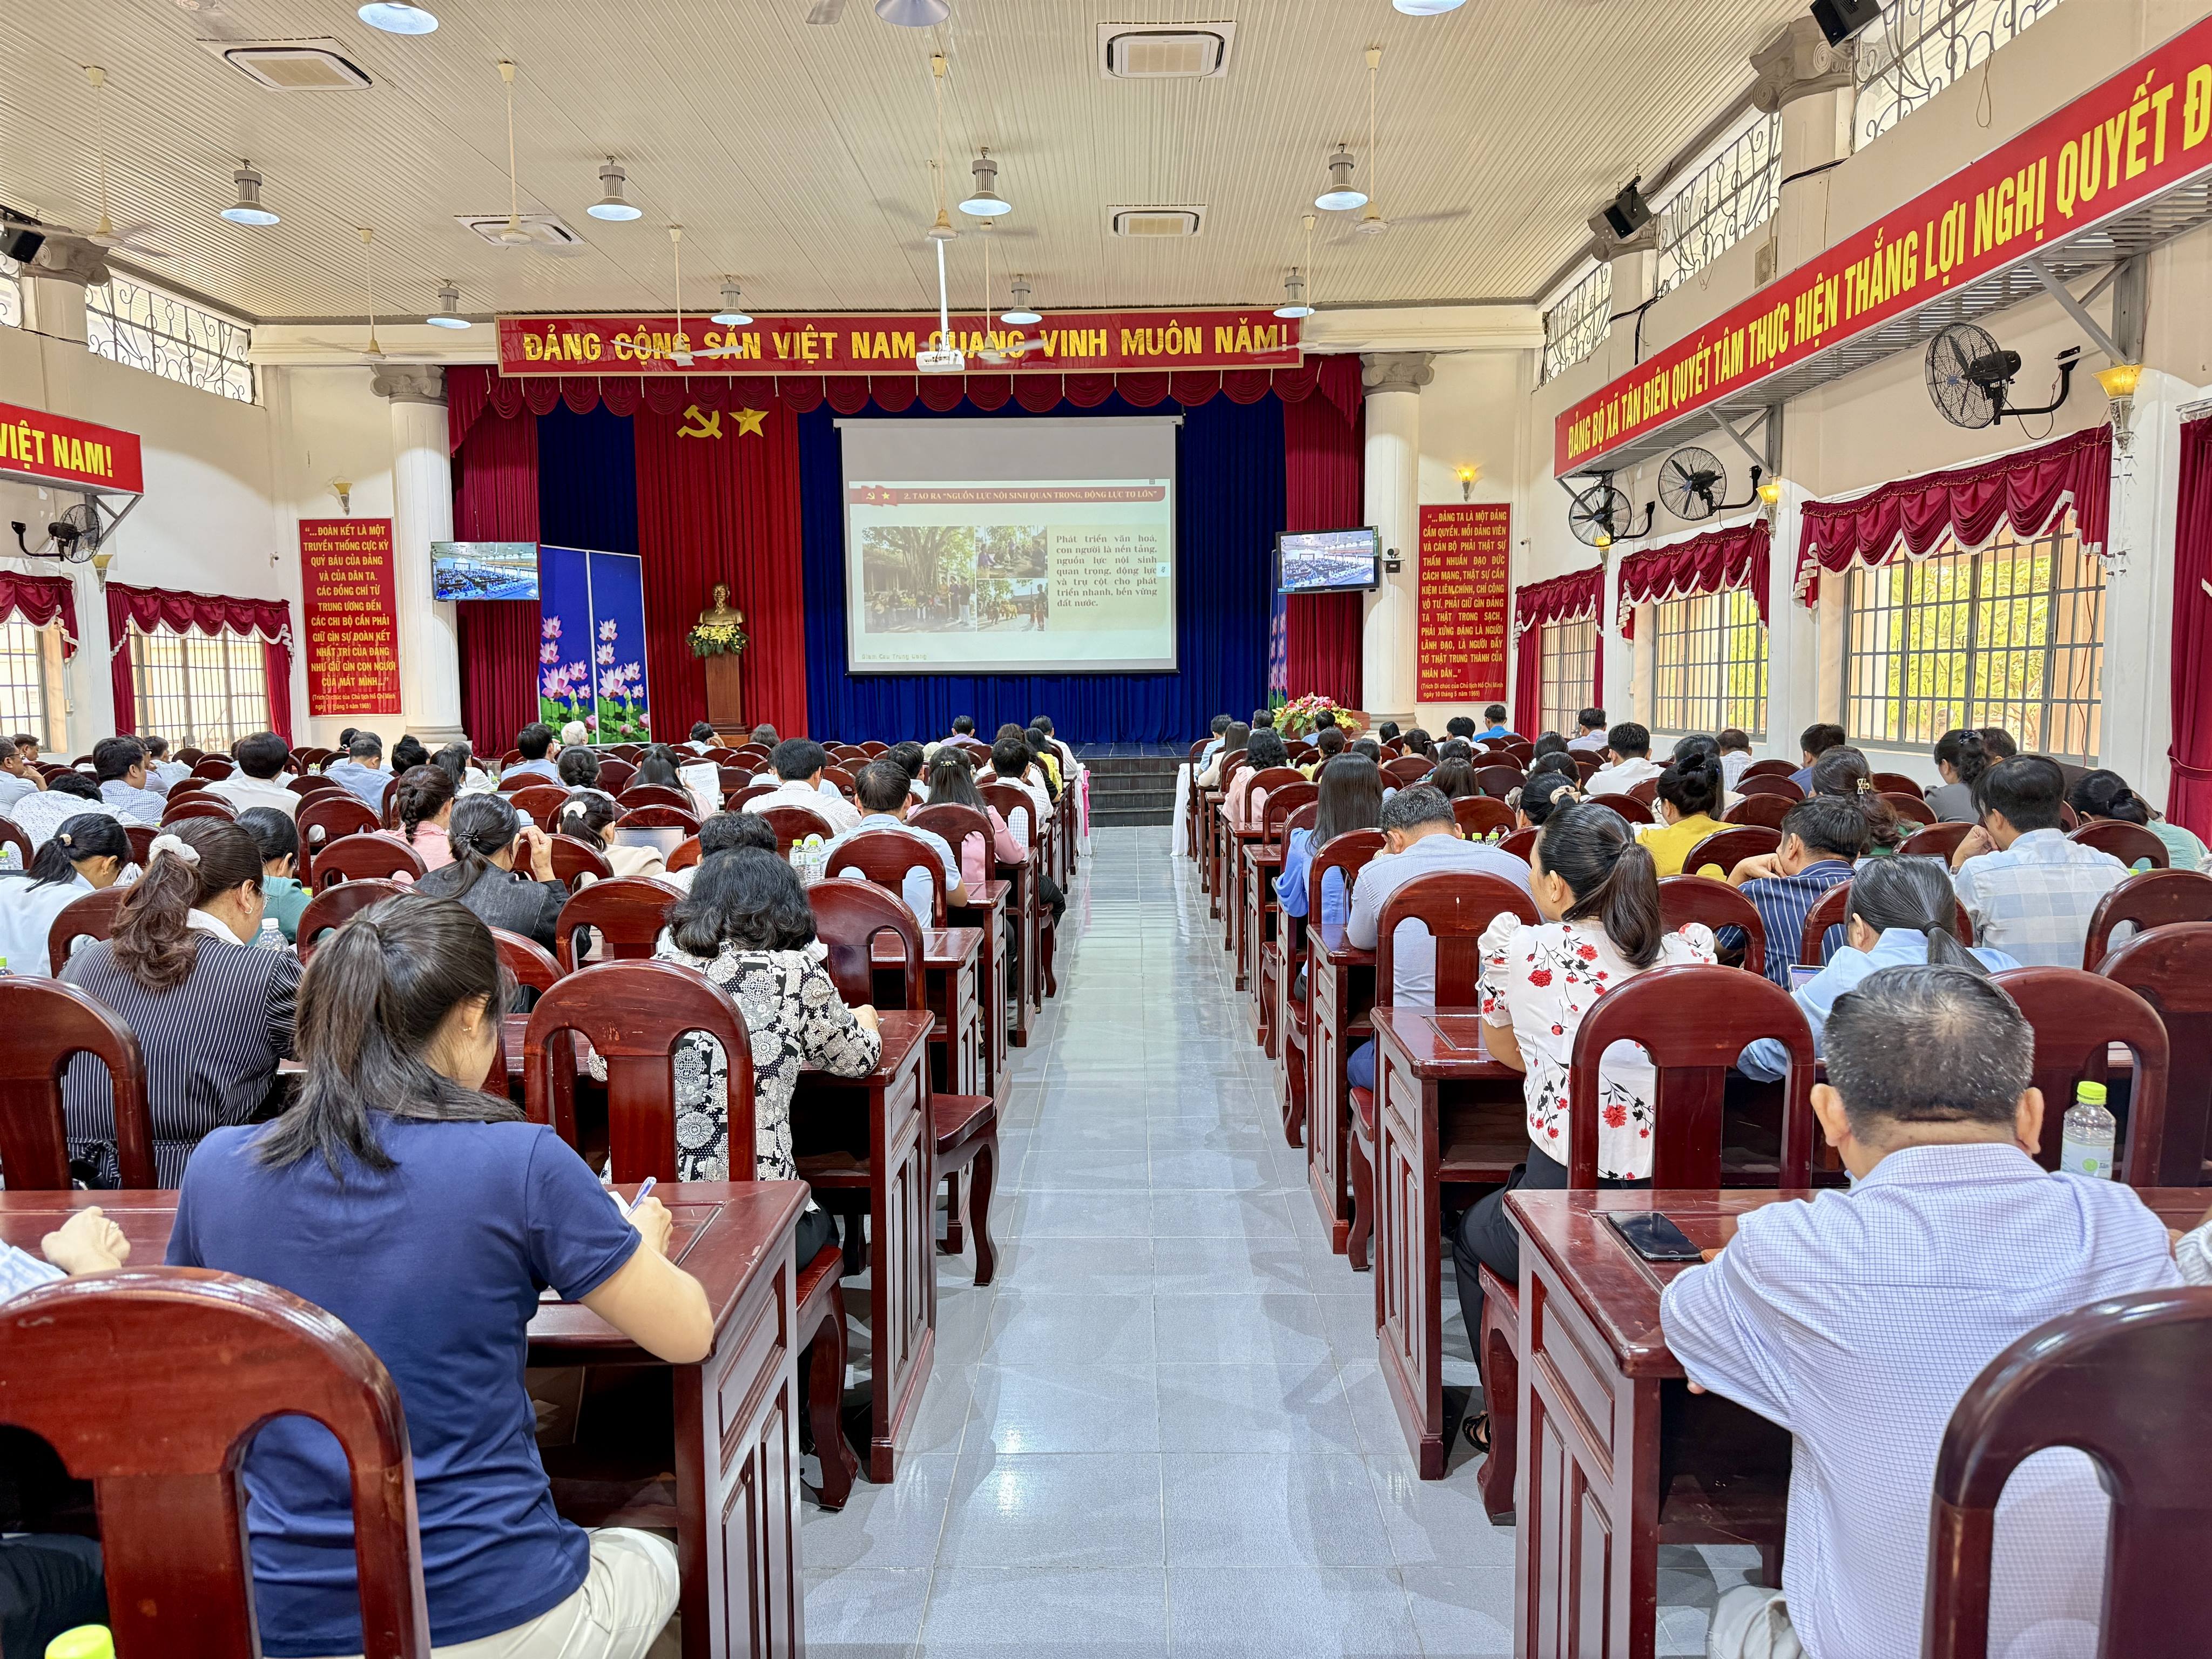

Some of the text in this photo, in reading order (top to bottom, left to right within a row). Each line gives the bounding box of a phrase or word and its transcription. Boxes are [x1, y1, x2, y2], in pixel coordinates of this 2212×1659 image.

[1568, 64, 2212, 460] ĐẢNG BỘ XÃ TÂN BIÊN QUYẾT TÂM THỰC HIỆN THẮNG LỢI NGHỊ QUYẾT Đ
[524, 325, 601, 361] ĐẢNG
[704, 325, 761, 359] SẢN
[773, 324, 838, 364] VIỆT
[853, 331, 916, 359] NAM
[1043, 329, 1107, 357] VINH
[1122, 320, 1202, 356] MUÔN
[1215, 318, 1286, 353] NĂM!
[52, 434, 113, 477] NAM!
[976, 492, 992, 500] LỰC
[994, 491, 1007, 500] NỘI
[1085, 491, 1106, 500] ĐỘNG
[1109, 491, 1123, 499] LỰC
[1439, 510, 1455, 522] ĐẢNG
[1456, 513, 1464, 521] TA
[1466, 510, 1473, 521] LÀ
[1475, 511, 1488, 523] MỘT
[1491, 509, 1506, 520] ĐẢNG
[340, 523, 354, 535] KẾT
[358, 524, 367, 535] LÀ
[369, 524, 385, 537] MỘT
[1461, 523, 1472, 536] MỖI
[1474, 523, 1491, 536] ĐẢNG
[1492, 523, 1506, 535] VIÊN
[335, 538, 360, 550] THỐNG
[362, 541, 376, 552] CỰC
[1424, 539, 1506, 552] VÀ CÁN BỘ PHẢI THẬT SỰ
[311, 553, 382, 567] QUÝ BÁU CỦA ĐẢNG
[1473, 556, 1486, 566] ĐẠO
[1492, 554, 1505, 564] ĐỨC
[319, 569, 377, 581] VÀ CỦA DÂN TA.
[1117, 567, 1138, 575] động
[1144, 567, 1156, 575] lực
[1422, 570, 1439, 581] CÁCH
[1441, 571, 1461, 581] MẠNG,
[1463, 569, 1479, 581] THẬT
[1481, 569, 1490, 581] SỰ
[1137, 577, 1157, 586] phát
[316, 585, 331, 596] CÁC
[355, 584, 368, 595] CHÍ
[1057, 588, 1078, 596] triển
[1136, 588, 1157, 596] vững
[1422, 611, 1502, 623] TA THẬT TRONG SẠCH,
[1421, 624, 1435, 636] PHẢI
[1457, 625, 1473, 635] ĐÁNG
[1475, 624, 1482, 635] LÀ
[1421, 640, 1437, 650] LÃNH
[1440, 641, 1454, 651] ĐẠO,
[1459, 639, 1466, 649] LÀ
[1432, 653, 1447, 665] THẬT
[1471, 652, 1489, 662] THÀNH
[1492, 650, 1502, 662] CỦA
[1422, 667, 1438, 678] NHÂN
